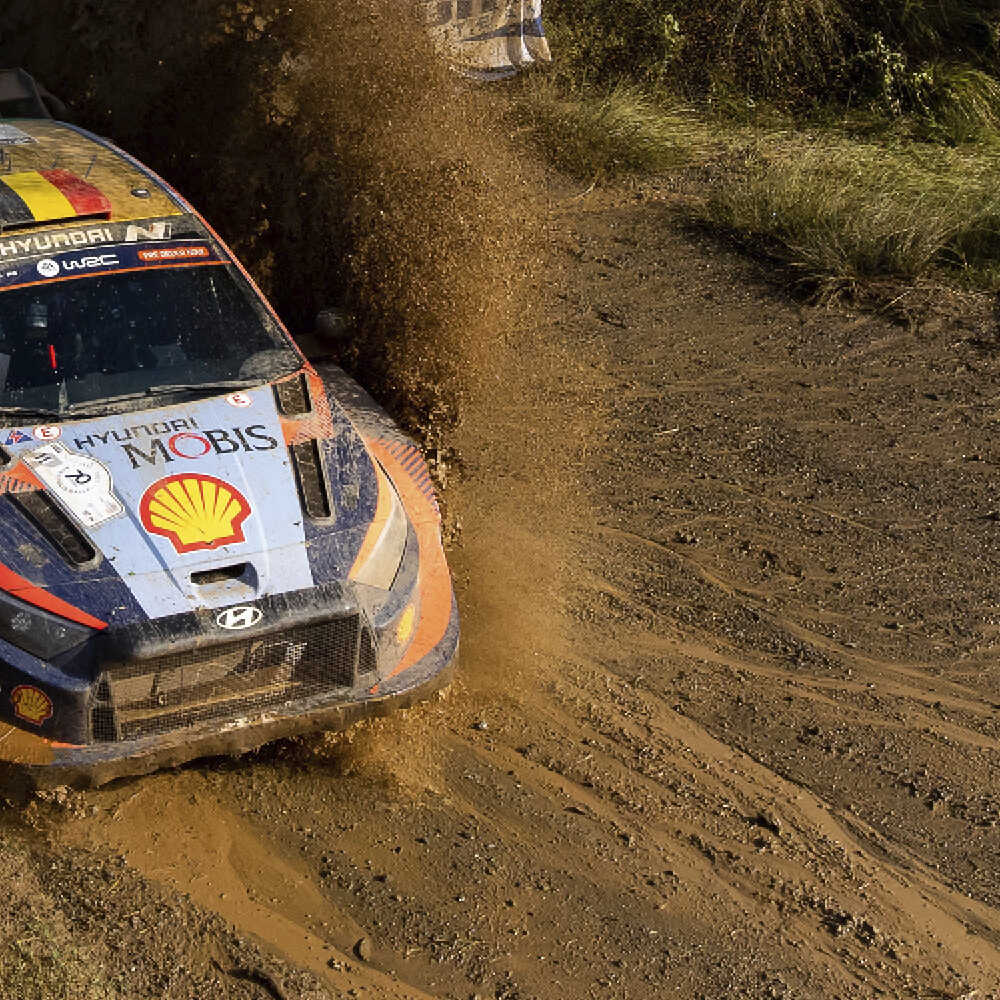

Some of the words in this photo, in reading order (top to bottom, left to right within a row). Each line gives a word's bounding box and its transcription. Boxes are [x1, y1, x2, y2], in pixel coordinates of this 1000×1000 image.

[61, 254, 120, 270] WRC
[72, 416, 200, 450] HYUNDAI
[120, 424, 278, 470] MOBIS
